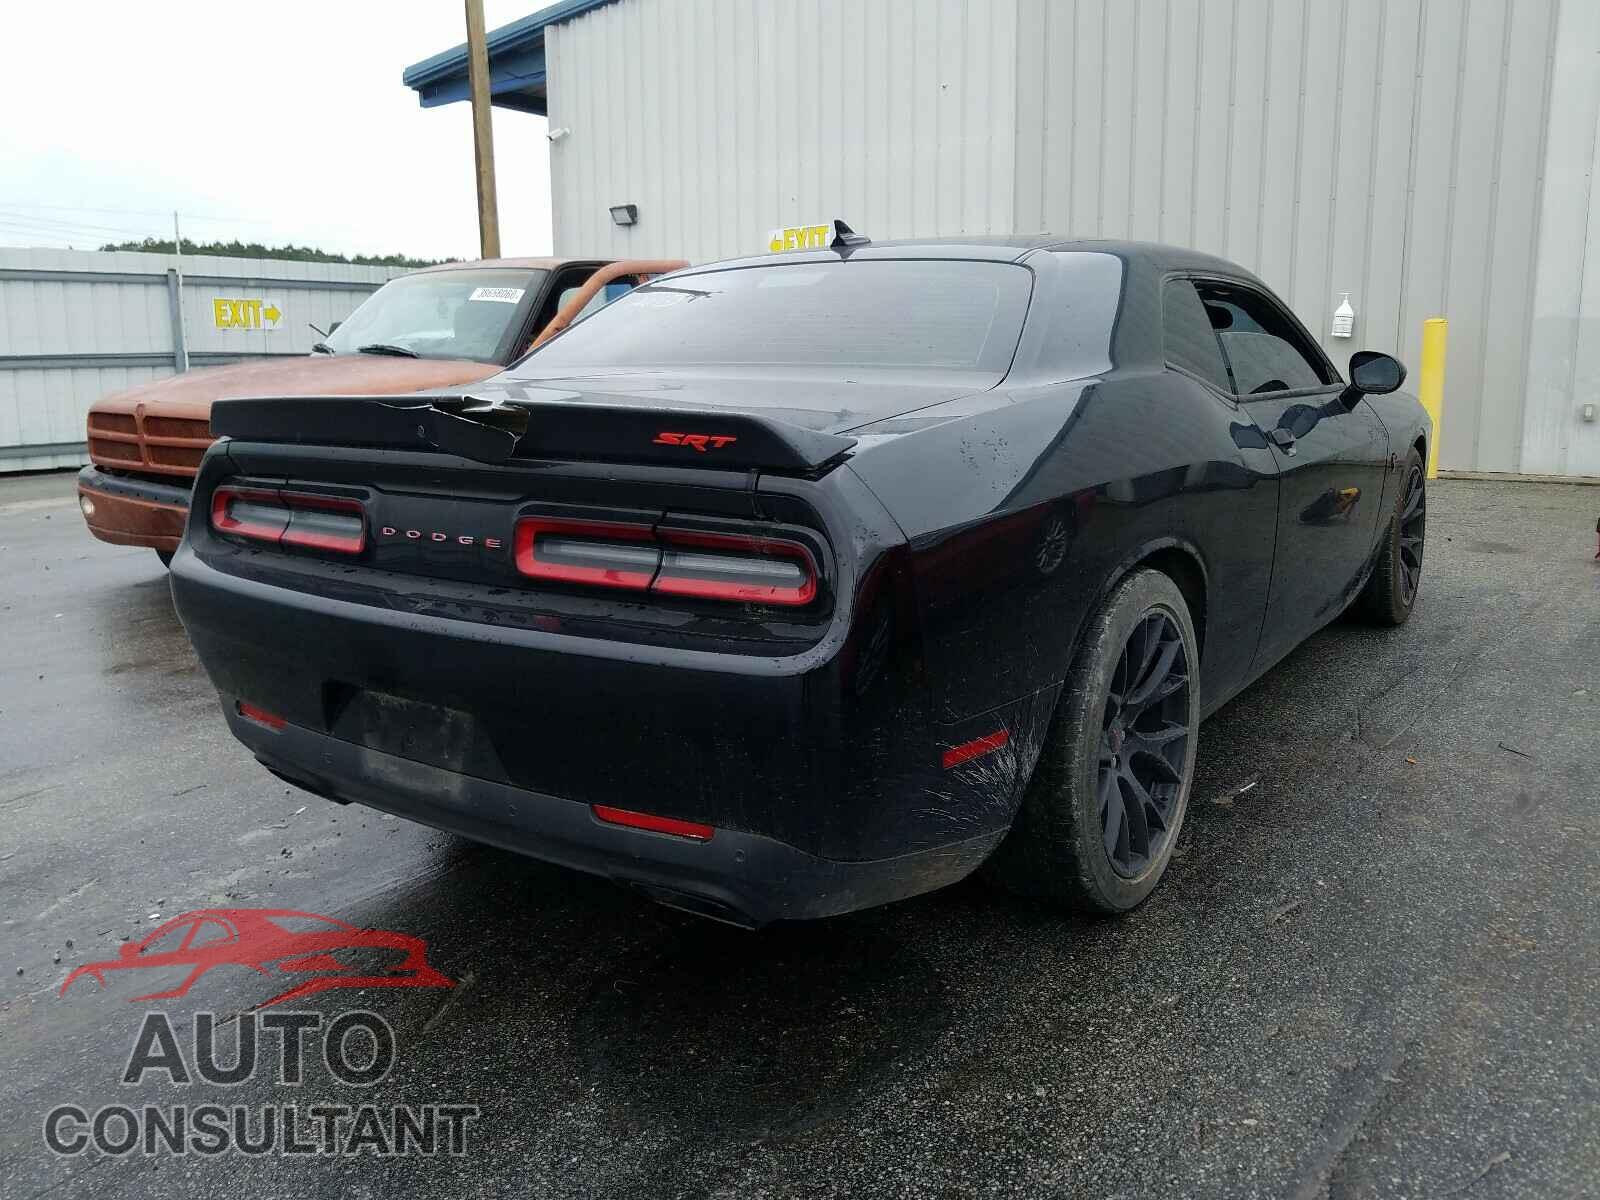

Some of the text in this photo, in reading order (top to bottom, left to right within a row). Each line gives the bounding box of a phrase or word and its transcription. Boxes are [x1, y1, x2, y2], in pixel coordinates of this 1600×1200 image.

[783, 226, 829, 251] EXIT
[214, 299, 263, 328] EXIT
[652, 432, 737, 451] SRT
[382, 526, 502, 548] DODGE
